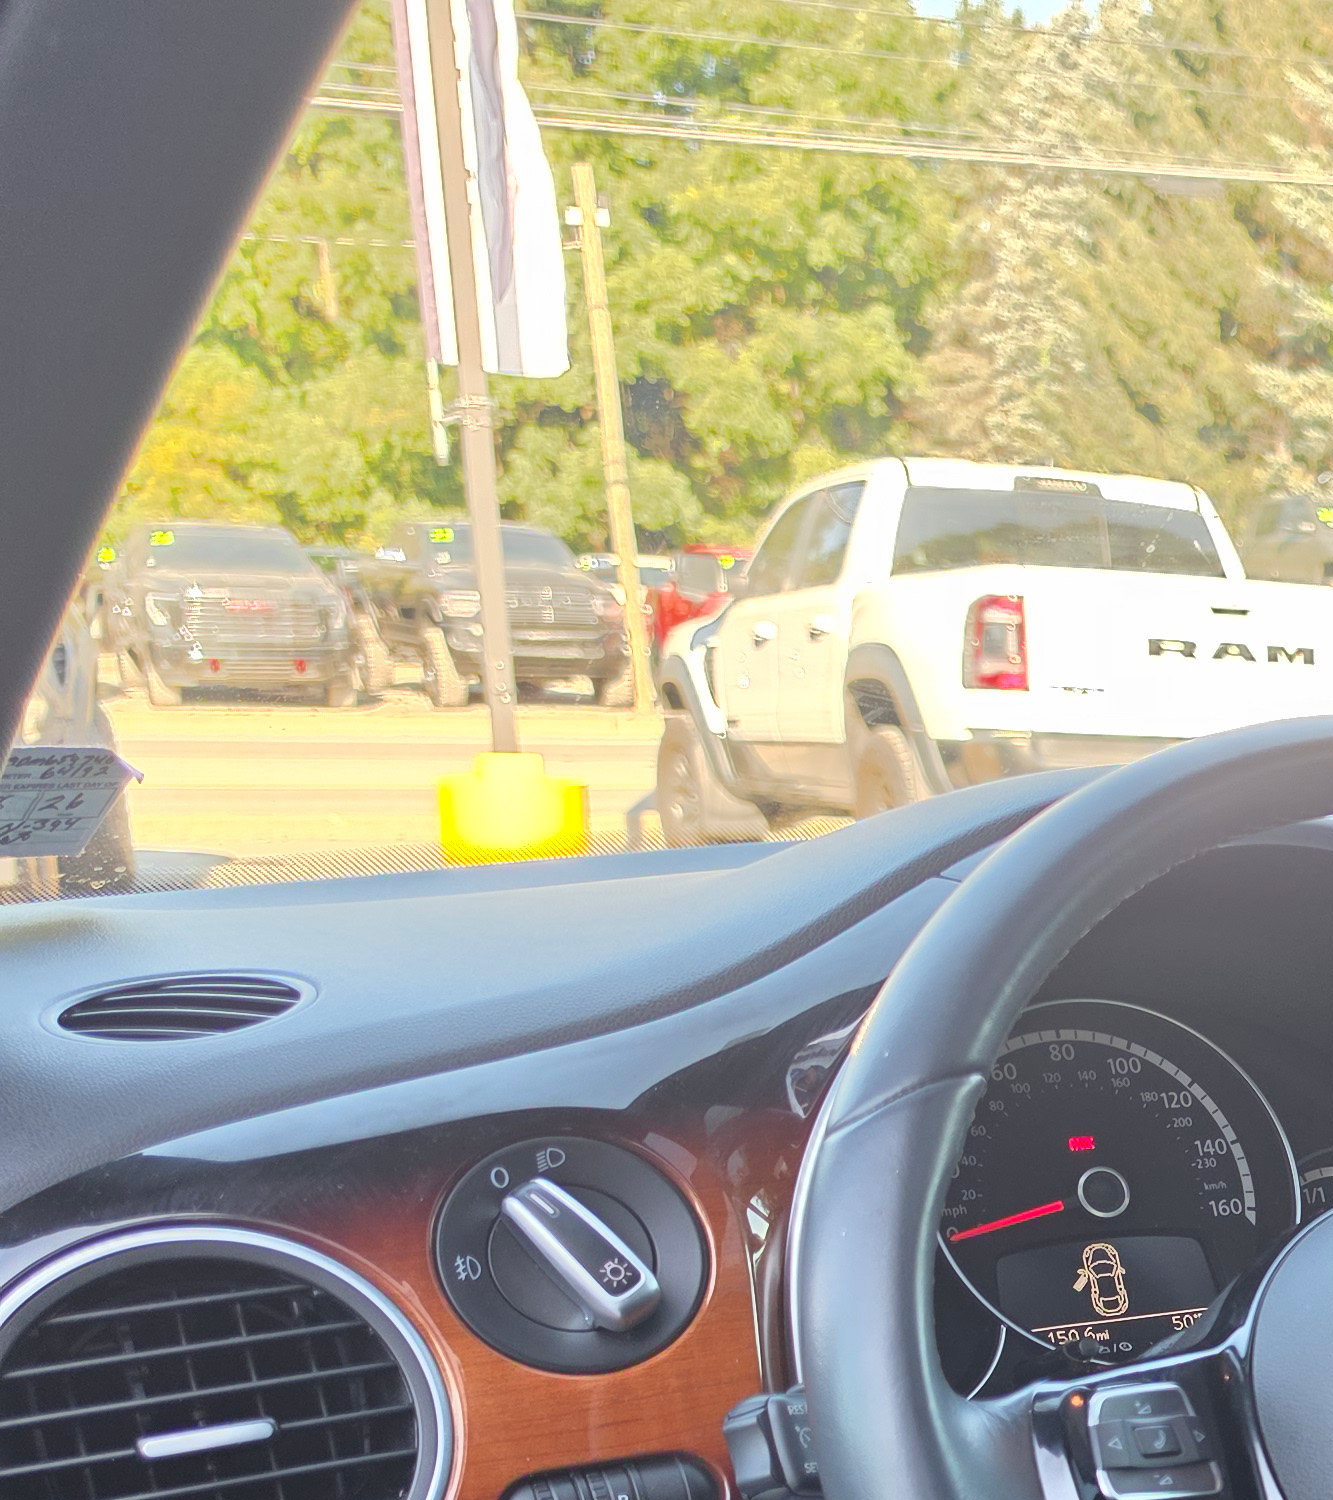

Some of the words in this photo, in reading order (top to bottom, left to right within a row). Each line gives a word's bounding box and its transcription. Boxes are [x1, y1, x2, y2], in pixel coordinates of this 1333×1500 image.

[1148, 638, 1315, 665] RAM
[1049, 1044, 1075, 1061] 80
[991, 1062, 1017, 1081] 60
[1107, 1057, 1142, 1075] 100
[1043, 1072, 1062, 1084] 120
[1077, 1070, 1097, 1081] 140
[1010, 1082, 1031, 1094] 100
[1111, 1077, 1131, 1088] 160
[1140, 1091, 1159, 1102] 180
[1160, 1091, 1193, 1109] 120
[988, 1100, 1005, 1112] 80
[1172, 1117, 1193, 1128] 200
[970, 1125, 987, 1137] 60
[1194, 1138, 1228, 1157] 140
[1197, 1157, 1217, 1169] 230
[1203, 1181, 1227, 1191] km/h
[961, 1189, 976, 1201] 20
[1303, 1186, 1326, 1205] 1/1
[941, 1205, 968, 1219] mph
[1208, 1198, 1243, 1217] 160
